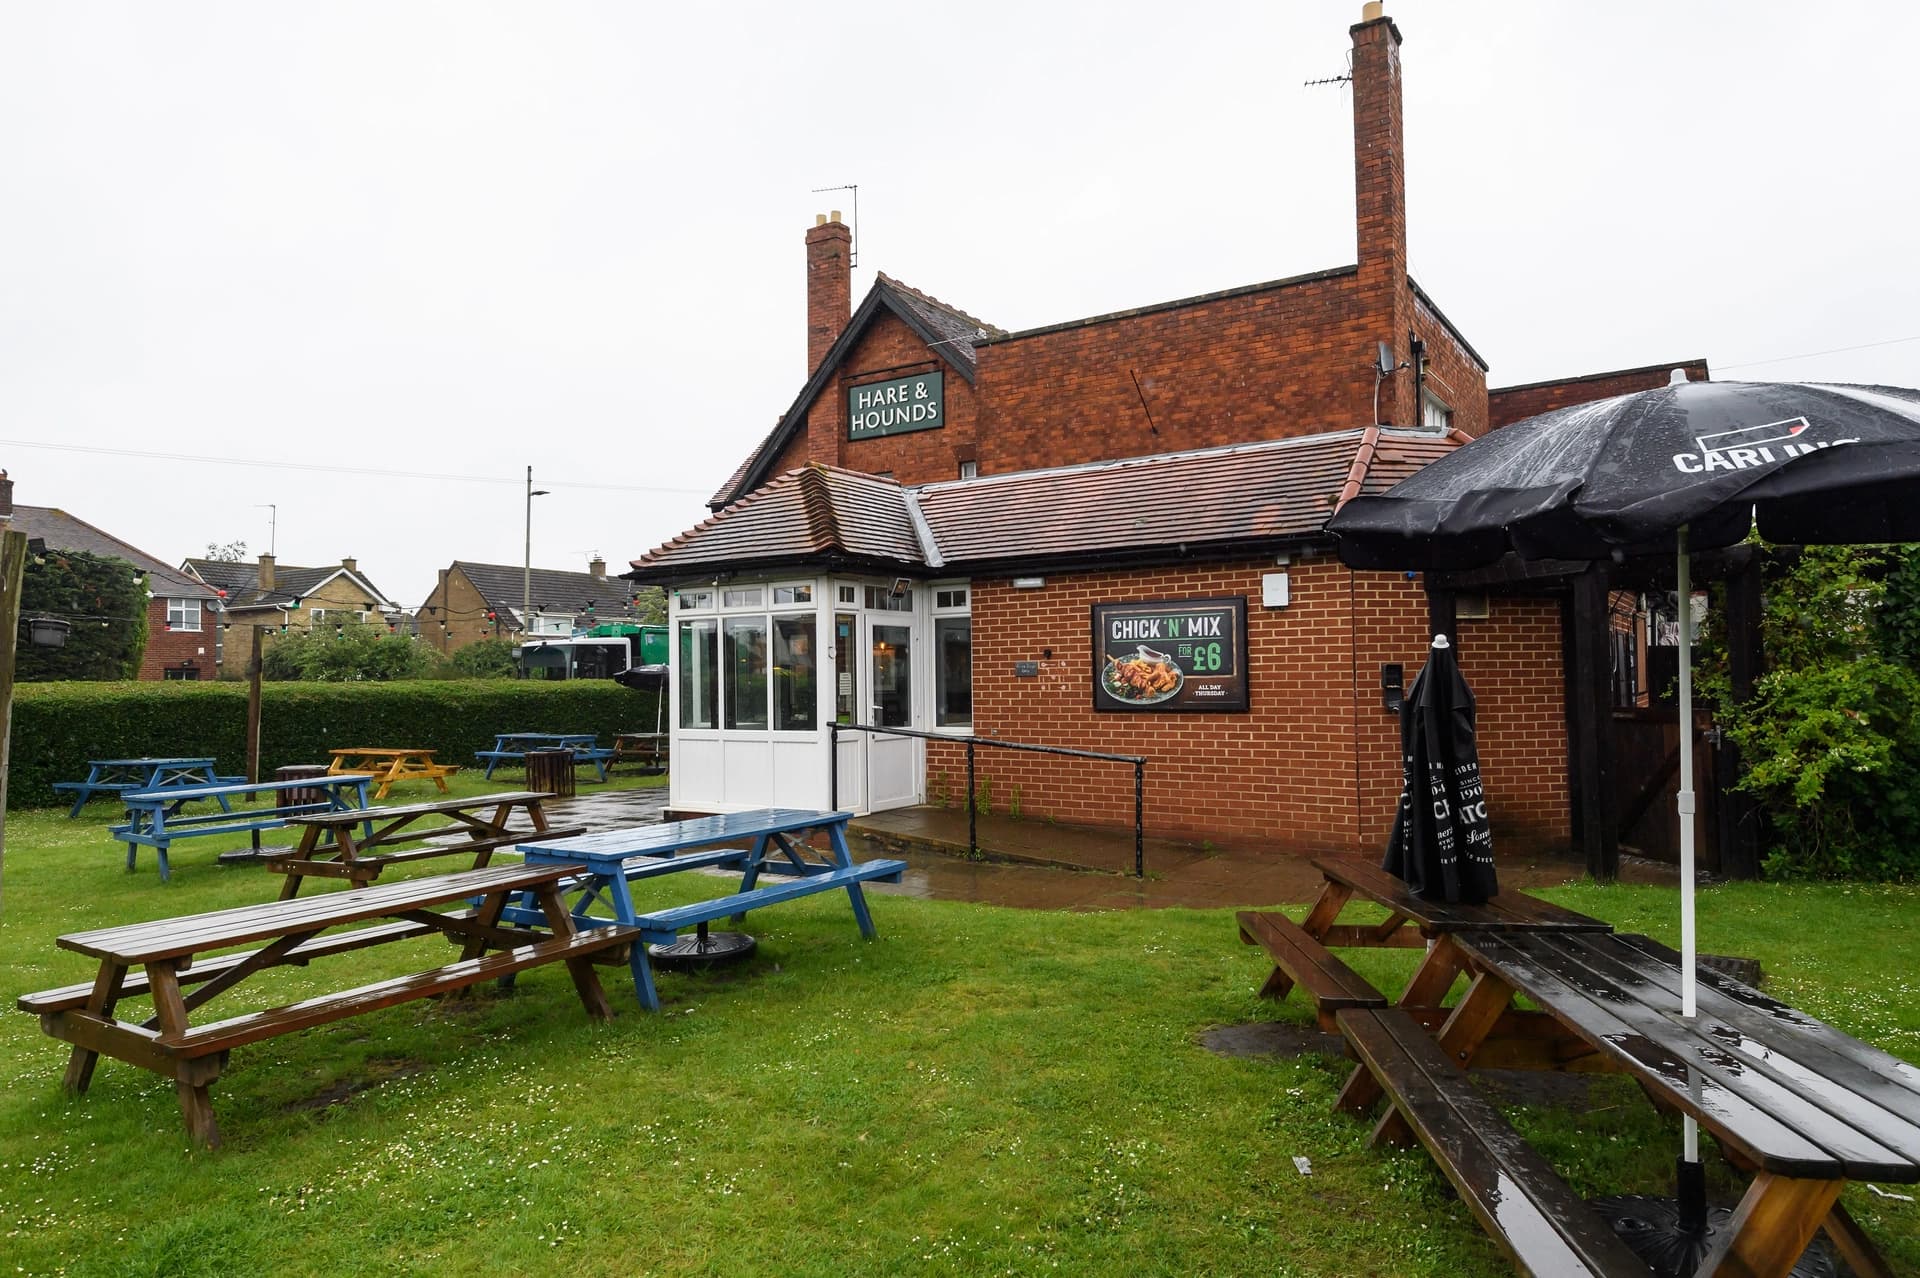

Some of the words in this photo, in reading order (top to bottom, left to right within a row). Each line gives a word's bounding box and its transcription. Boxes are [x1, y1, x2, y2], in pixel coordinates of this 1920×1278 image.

[859, 385, 908, 409] HARE
[915, 382, 928, 399] &
[852, 402, 937, 431] HOUNDS
[1672, 437, 1860, 473] CARLI
[1112, 619, 1160, 639] CHICK
[1188, 616, 1220, 637] MIX
[1178, 646, 1192, 656] FOR
[1193, 642, 1221, 671] £6
